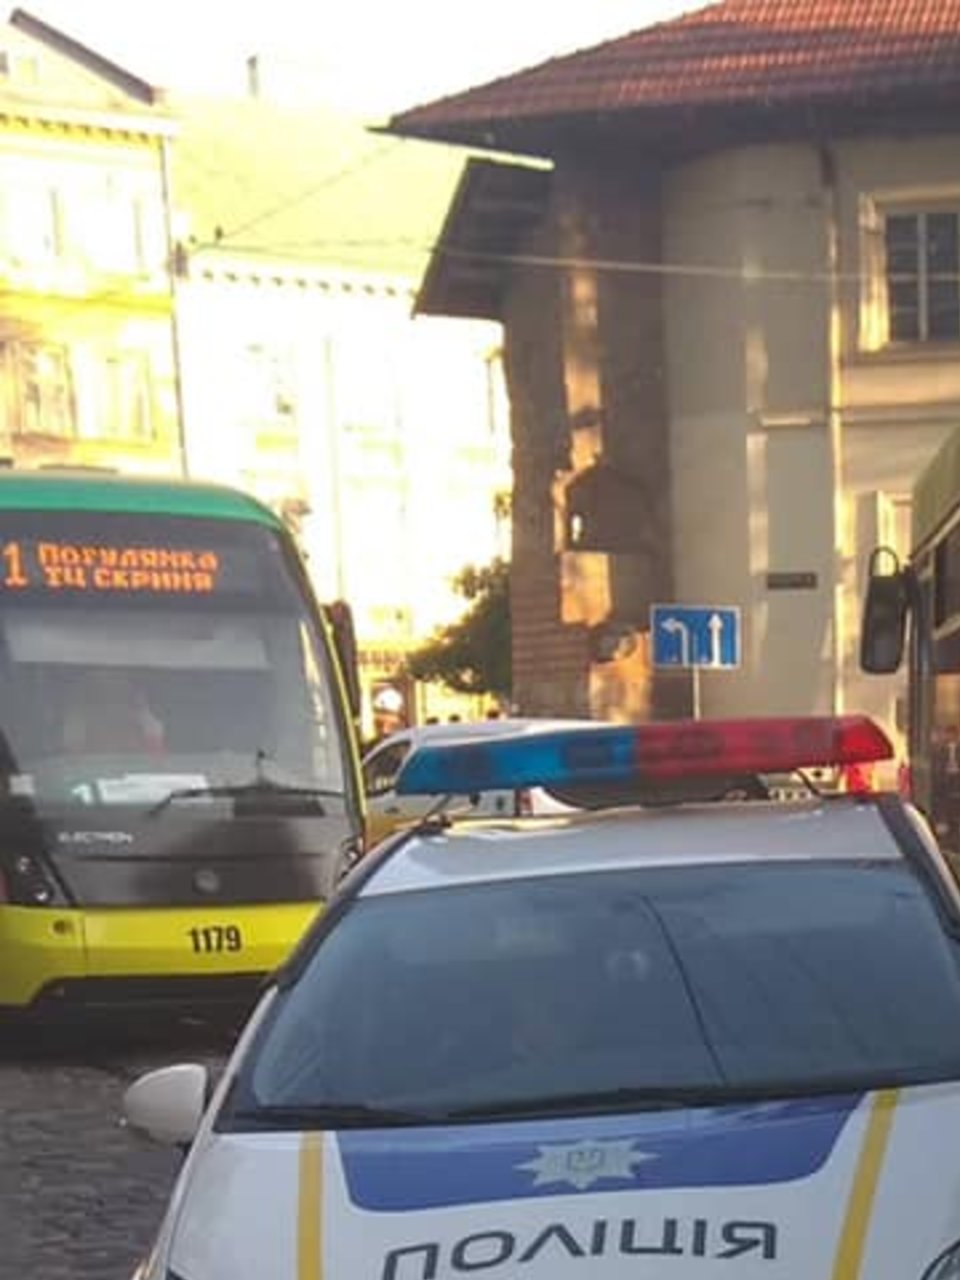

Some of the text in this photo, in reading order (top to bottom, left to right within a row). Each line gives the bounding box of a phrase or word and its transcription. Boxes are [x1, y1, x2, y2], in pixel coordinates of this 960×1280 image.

[4, 541, 29, 587] 1
[45, 566, 87, 588] ТЦ
[187, 924, 242, 953] 1179
